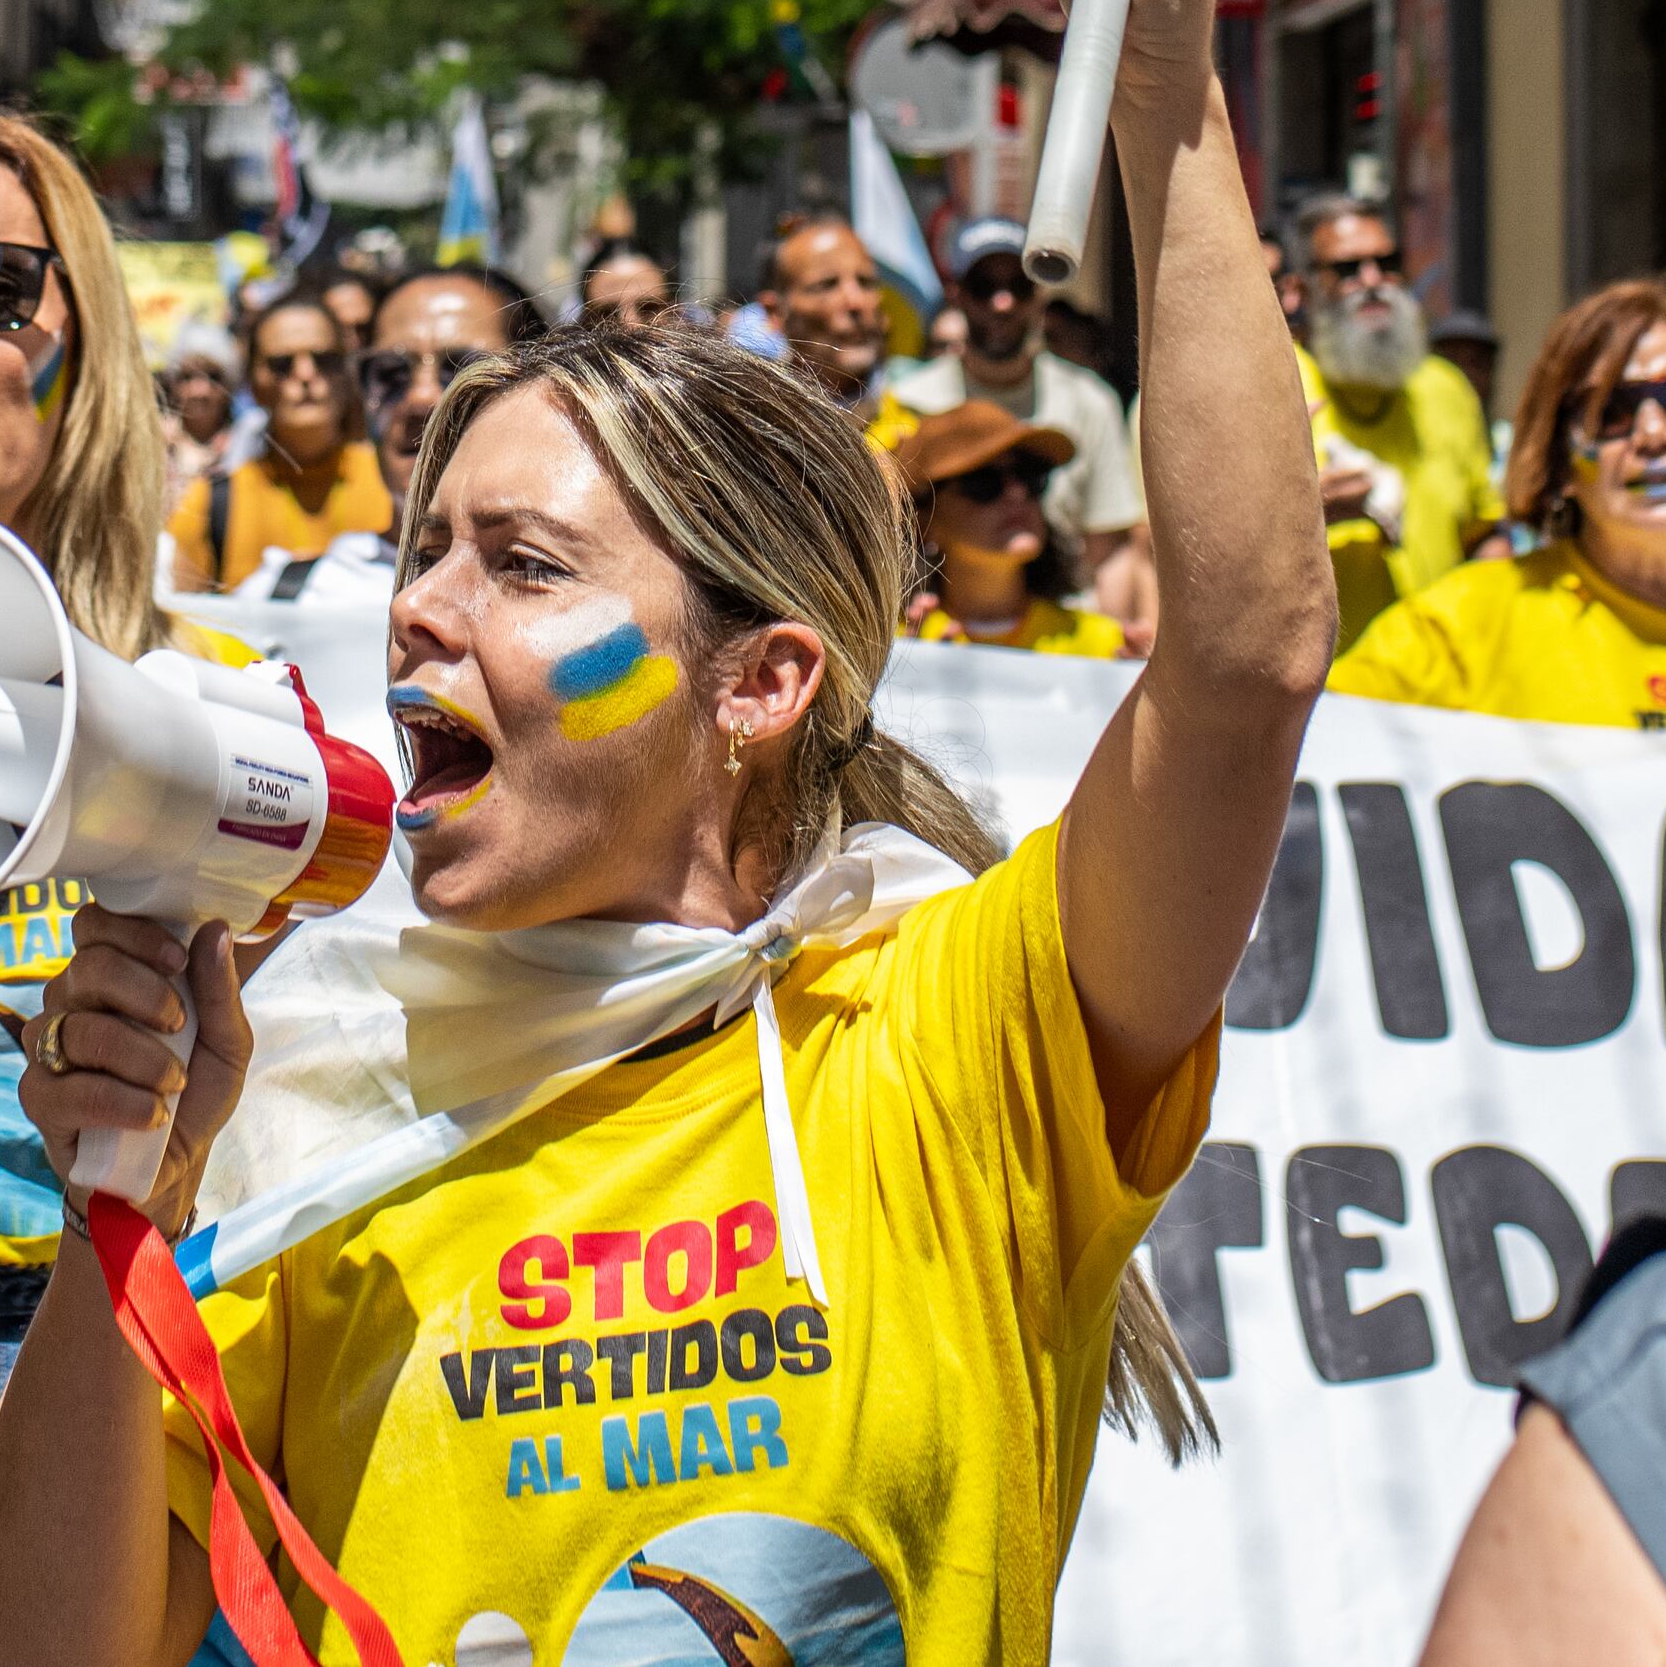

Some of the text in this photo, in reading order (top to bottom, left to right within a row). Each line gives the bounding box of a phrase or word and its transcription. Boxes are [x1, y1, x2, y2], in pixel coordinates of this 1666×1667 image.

[245, 798, 287, 822] SD-6588
[248, 776, 290, 802] SANDA
[498, 1200, 778, 1330] STOP
[439, 1304, 832, 1421] VERTIDOS
[506, 1395, 789, 1498] AL MAR
